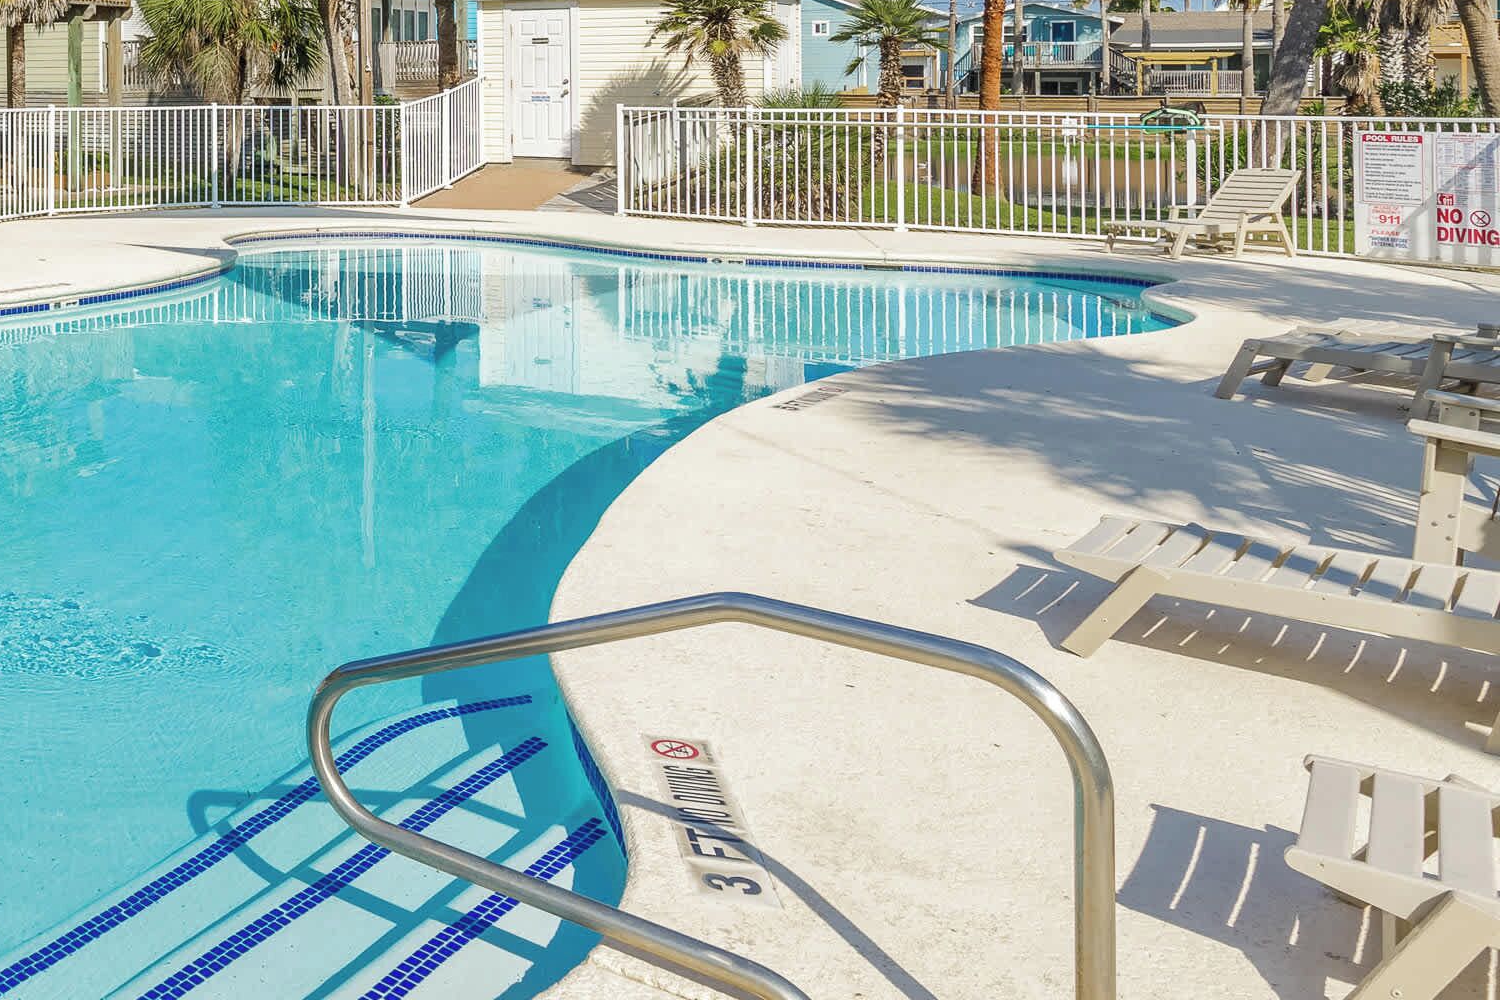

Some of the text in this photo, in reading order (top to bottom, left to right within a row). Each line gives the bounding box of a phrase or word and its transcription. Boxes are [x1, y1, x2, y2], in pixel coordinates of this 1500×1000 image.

[1379, 214, 1400, 224] 911
[1437, 208, 1463, 224] NO
[1437, 226, 1500, 245] DIVING
[663, 766, 762, 895] 3 FT NO DIVING
